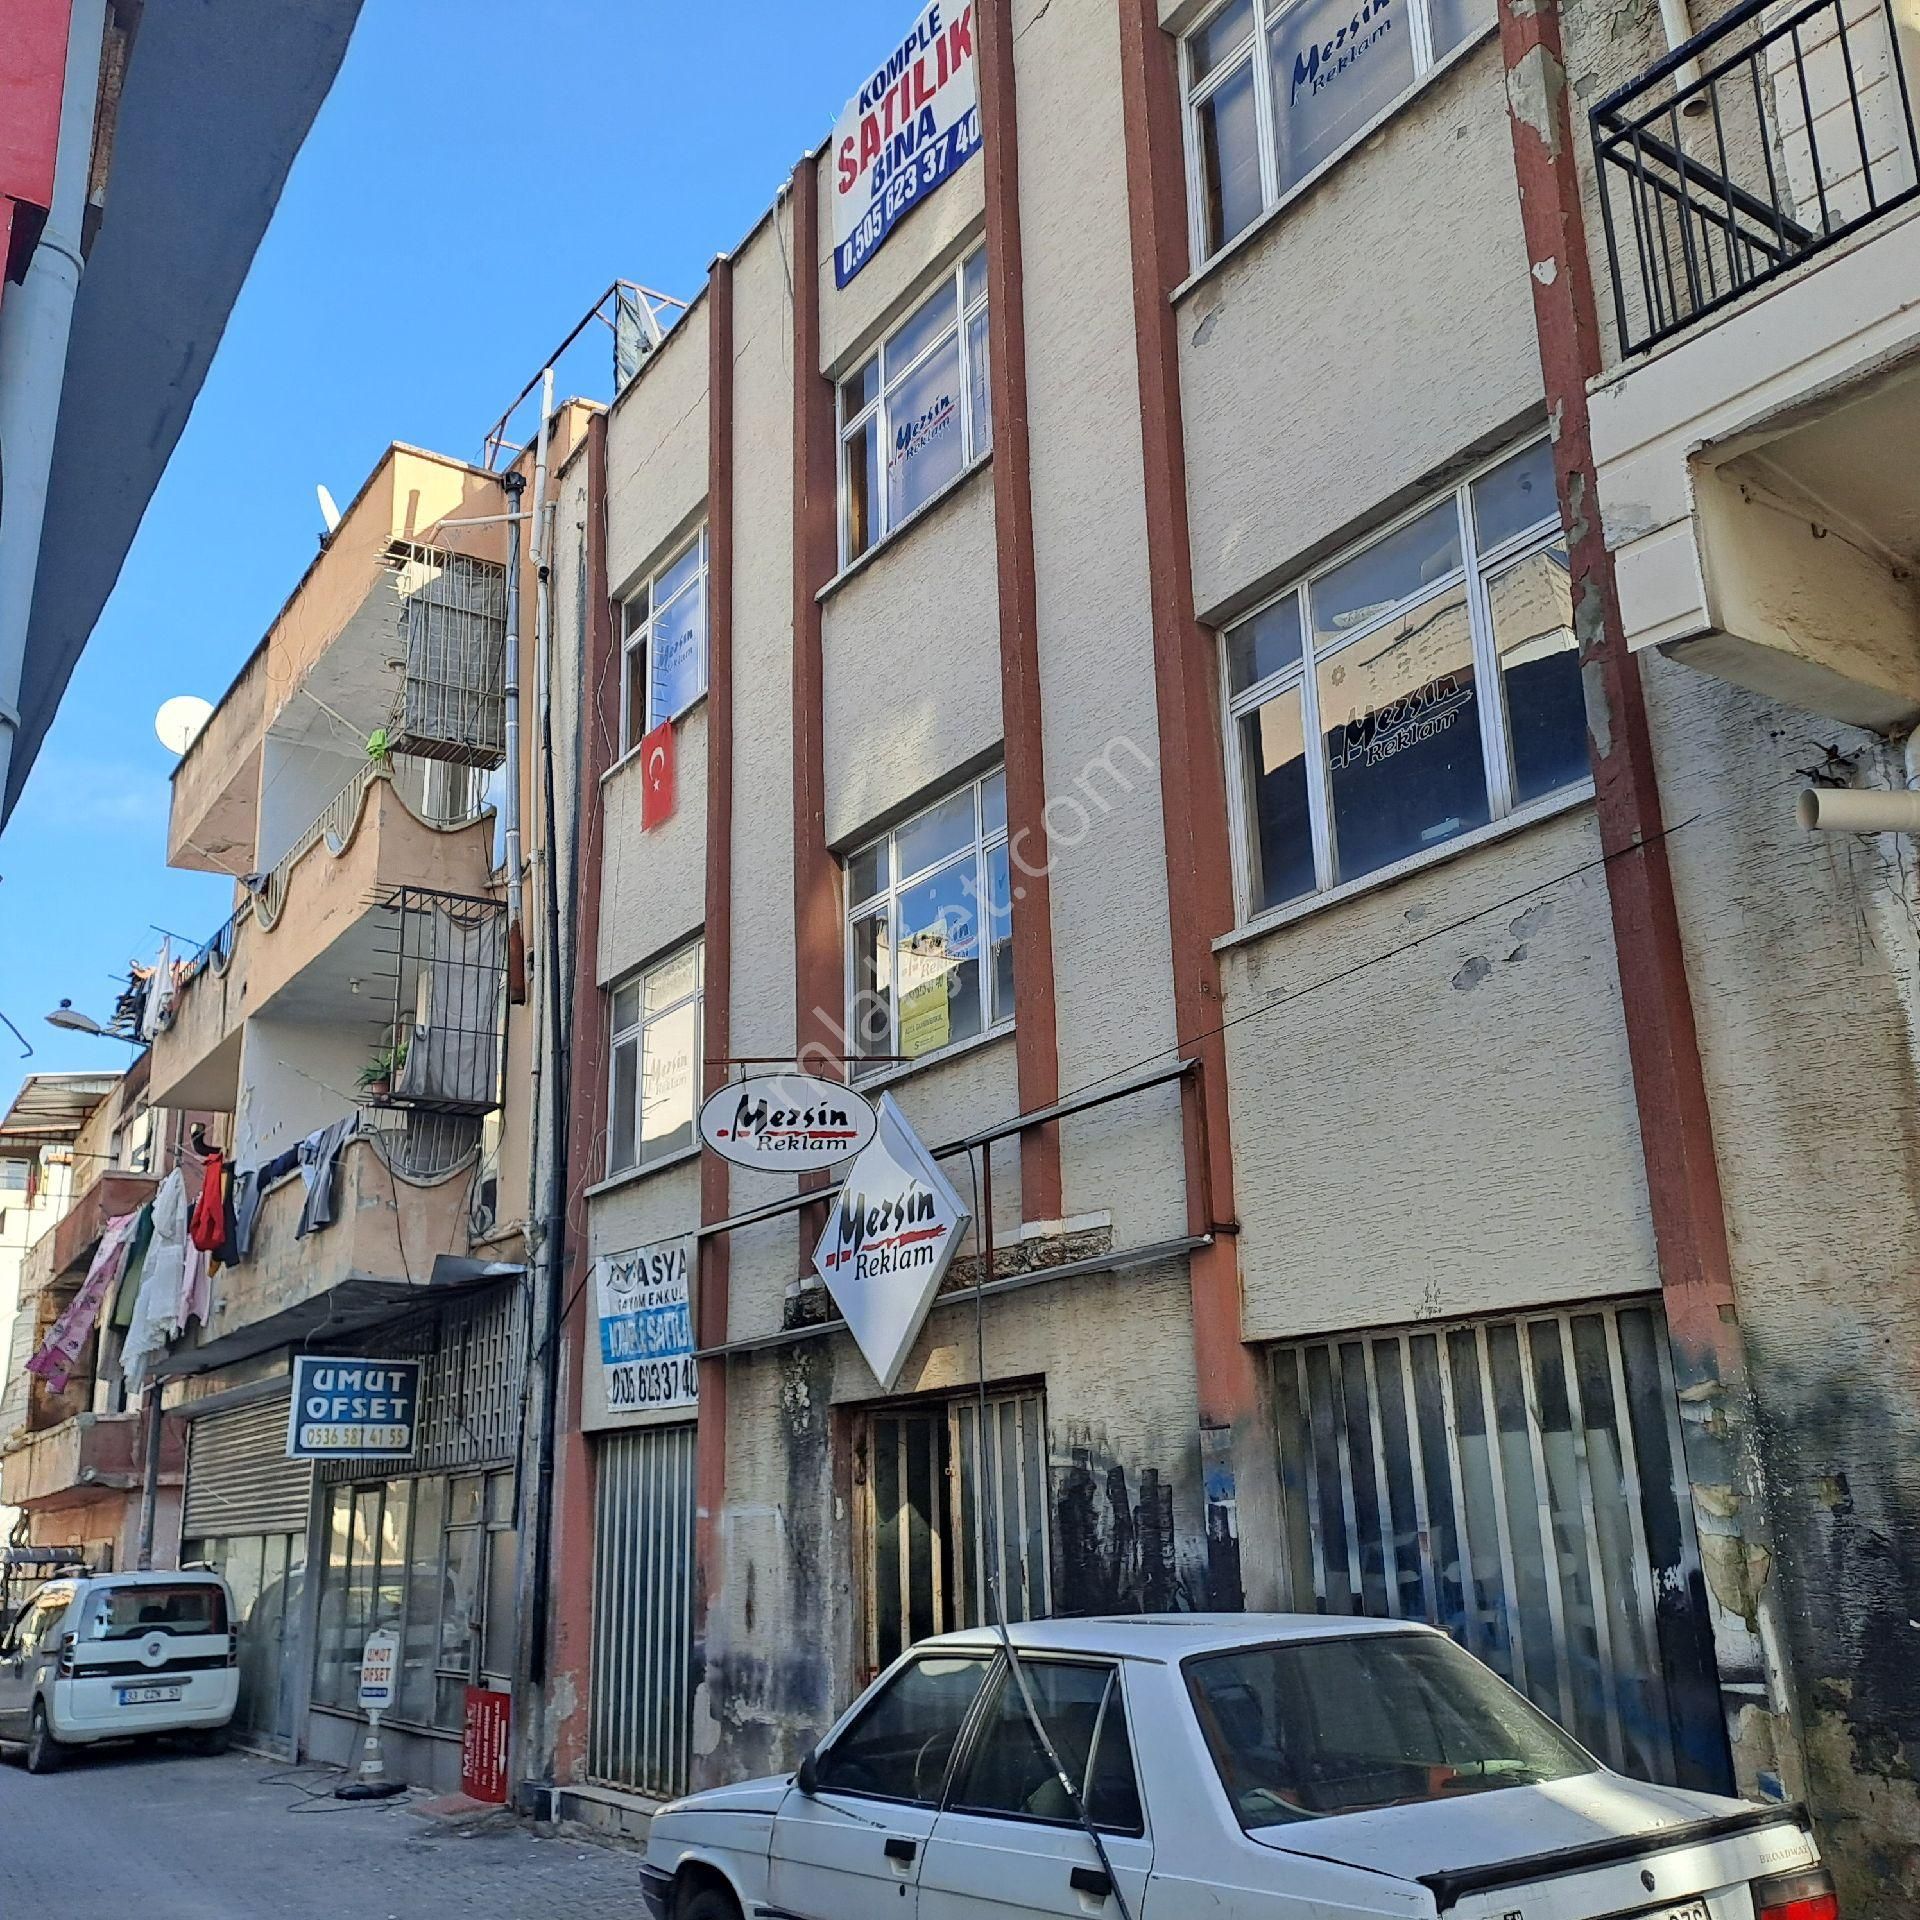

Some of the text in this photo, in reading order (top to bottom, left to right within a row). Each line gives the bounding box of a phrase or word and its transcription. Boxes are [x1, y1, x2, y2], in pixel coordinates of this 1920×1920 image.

[858, 3, 942, 116] KOMPLE
[1312, 19, 1391, 97] Reklam
[838, 6, 972, 195] SATILIK
[885, 165, 917, 218] 623
[922, 134, 949, 184] 37
[956, 109, 979, 153] 40
[1342, 674, 1460, 768] Mersin
[1366, 709, 1460, 767] Reklam
[732, 1094, 848, 1142] Mersin
[756, 1135, 848, 1152] Reklam
[835, 1178, 936, 1272] Mersin
[854, 1245, 935, 1281] Reklam
[312, 1369, 407, 1392] UMUT
[661, 1361, 678, 1400] 37
[682, 1359, 699, 1398] 40
[306, 1397, 408, 1420] OFSET
[307, 1427, 338, 1446] 0536
[1759, 1845, 1808, 1864] BROADWAY
